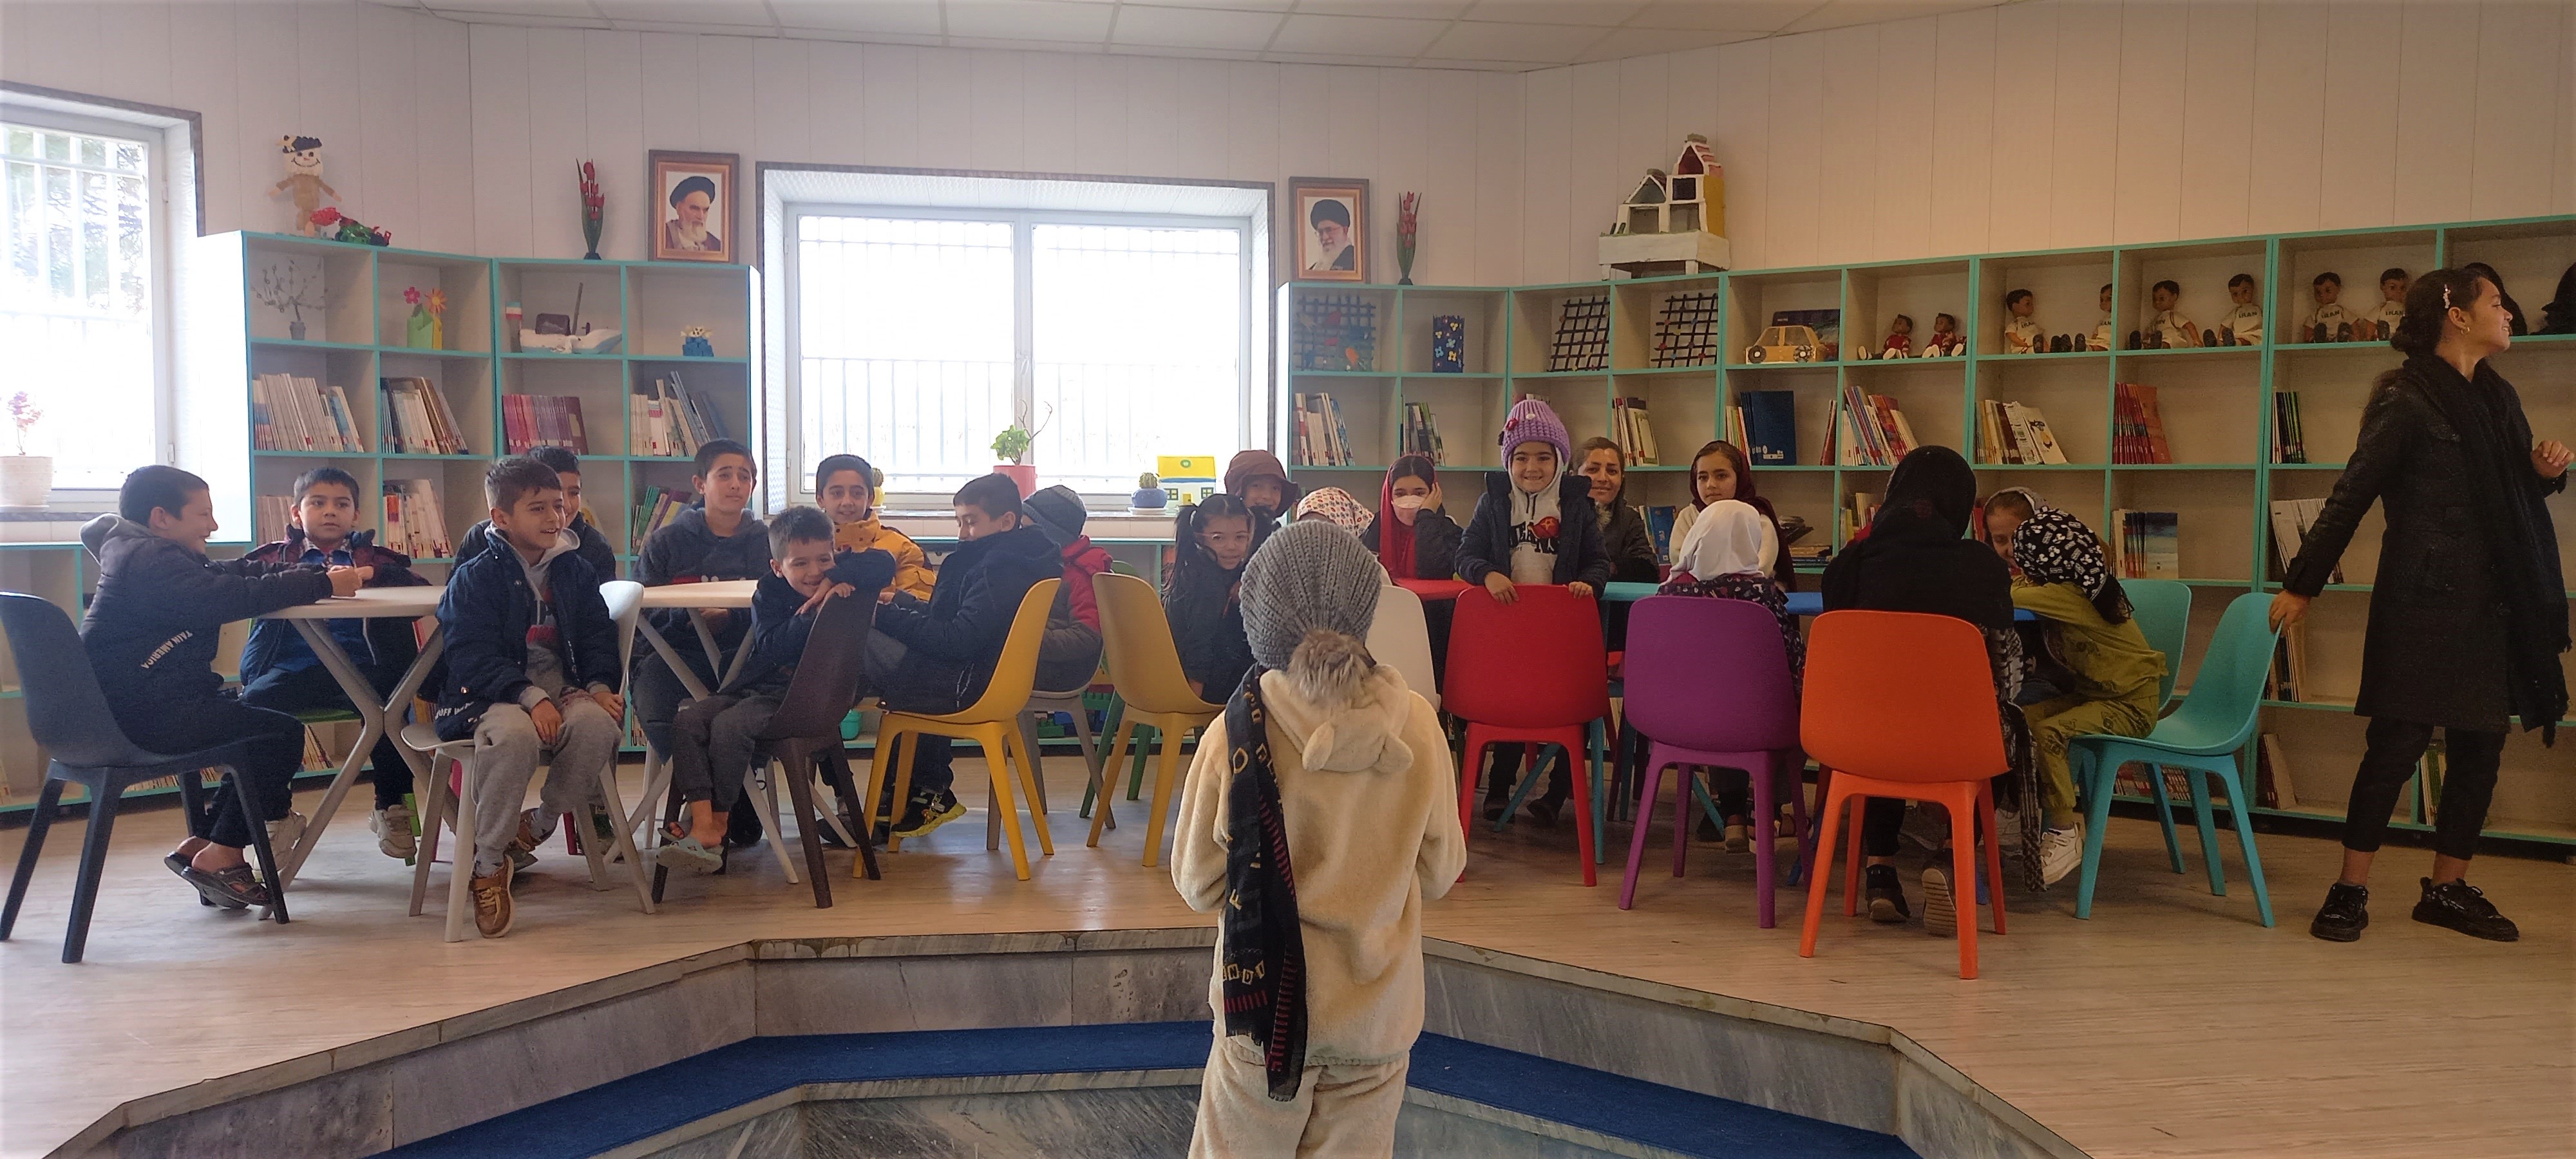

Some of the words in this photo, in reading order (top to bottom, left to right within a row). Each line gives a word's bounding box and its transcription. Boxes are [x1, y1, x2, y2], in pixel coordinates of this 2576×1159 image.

[2321, 310, 2340, 318] IRAN
[170, 630, 193, 645] TAIN
[140, 640, 175, 669] AMERICA
